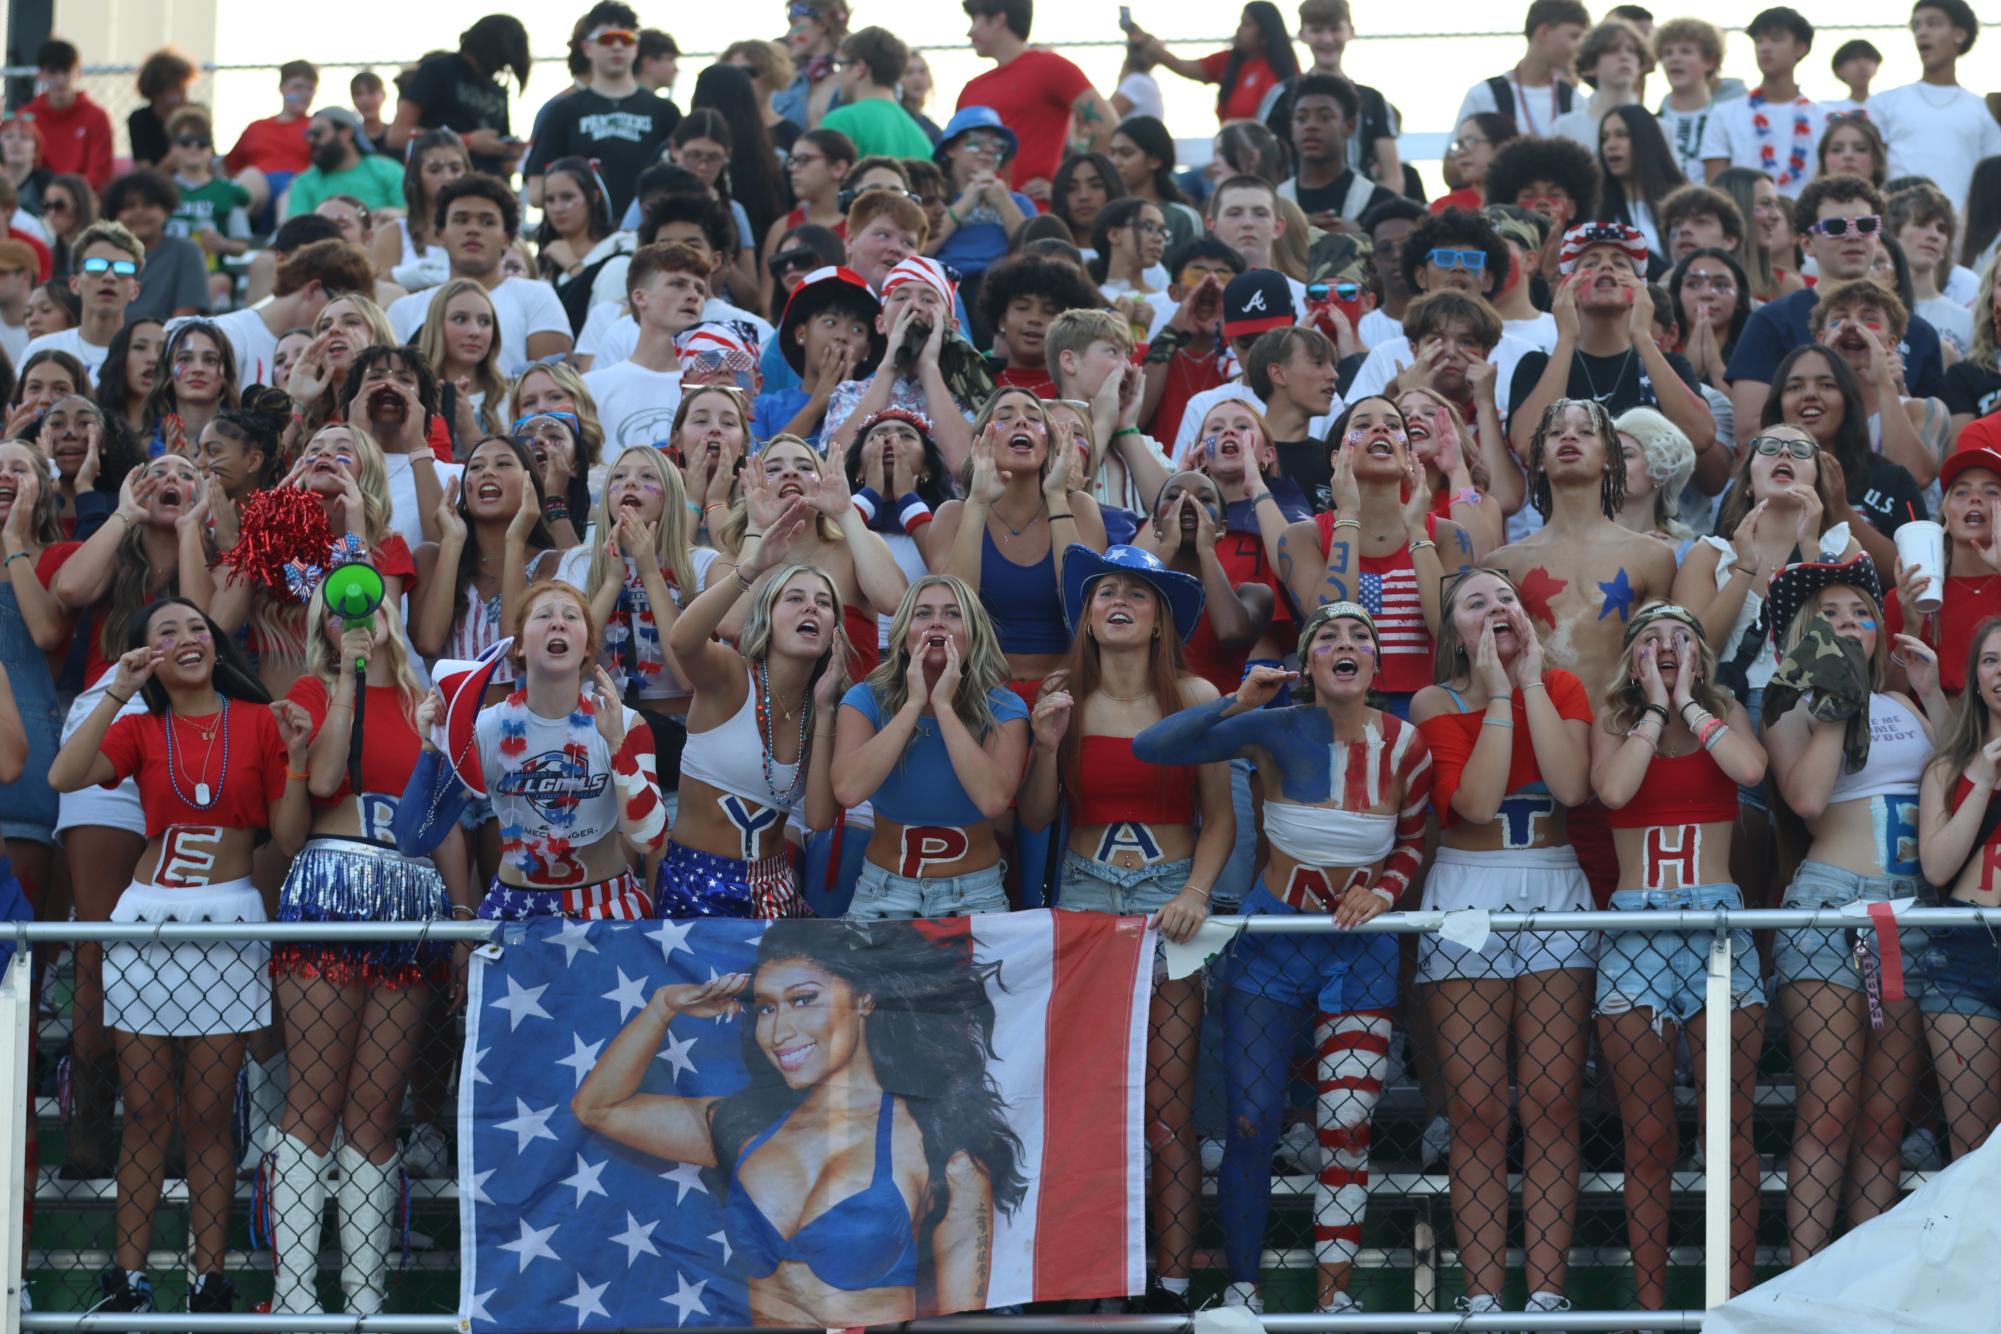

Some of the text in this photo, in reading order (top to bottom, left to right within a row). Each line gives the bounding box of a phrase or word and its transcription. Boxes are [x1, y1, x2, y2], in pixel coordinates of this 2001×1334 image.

[1241, 289, 1267, 312] A
[1871, 729, 1915, 742] BOY
[716, 793, 779, 861] Y
[1092, 821, 1165, 865] A
[1494, 793, 1555, 849] T
[152, 823, 223, 888] E
[899, 825, 969, 880] P
[1642, 823, 1702, 891] H
